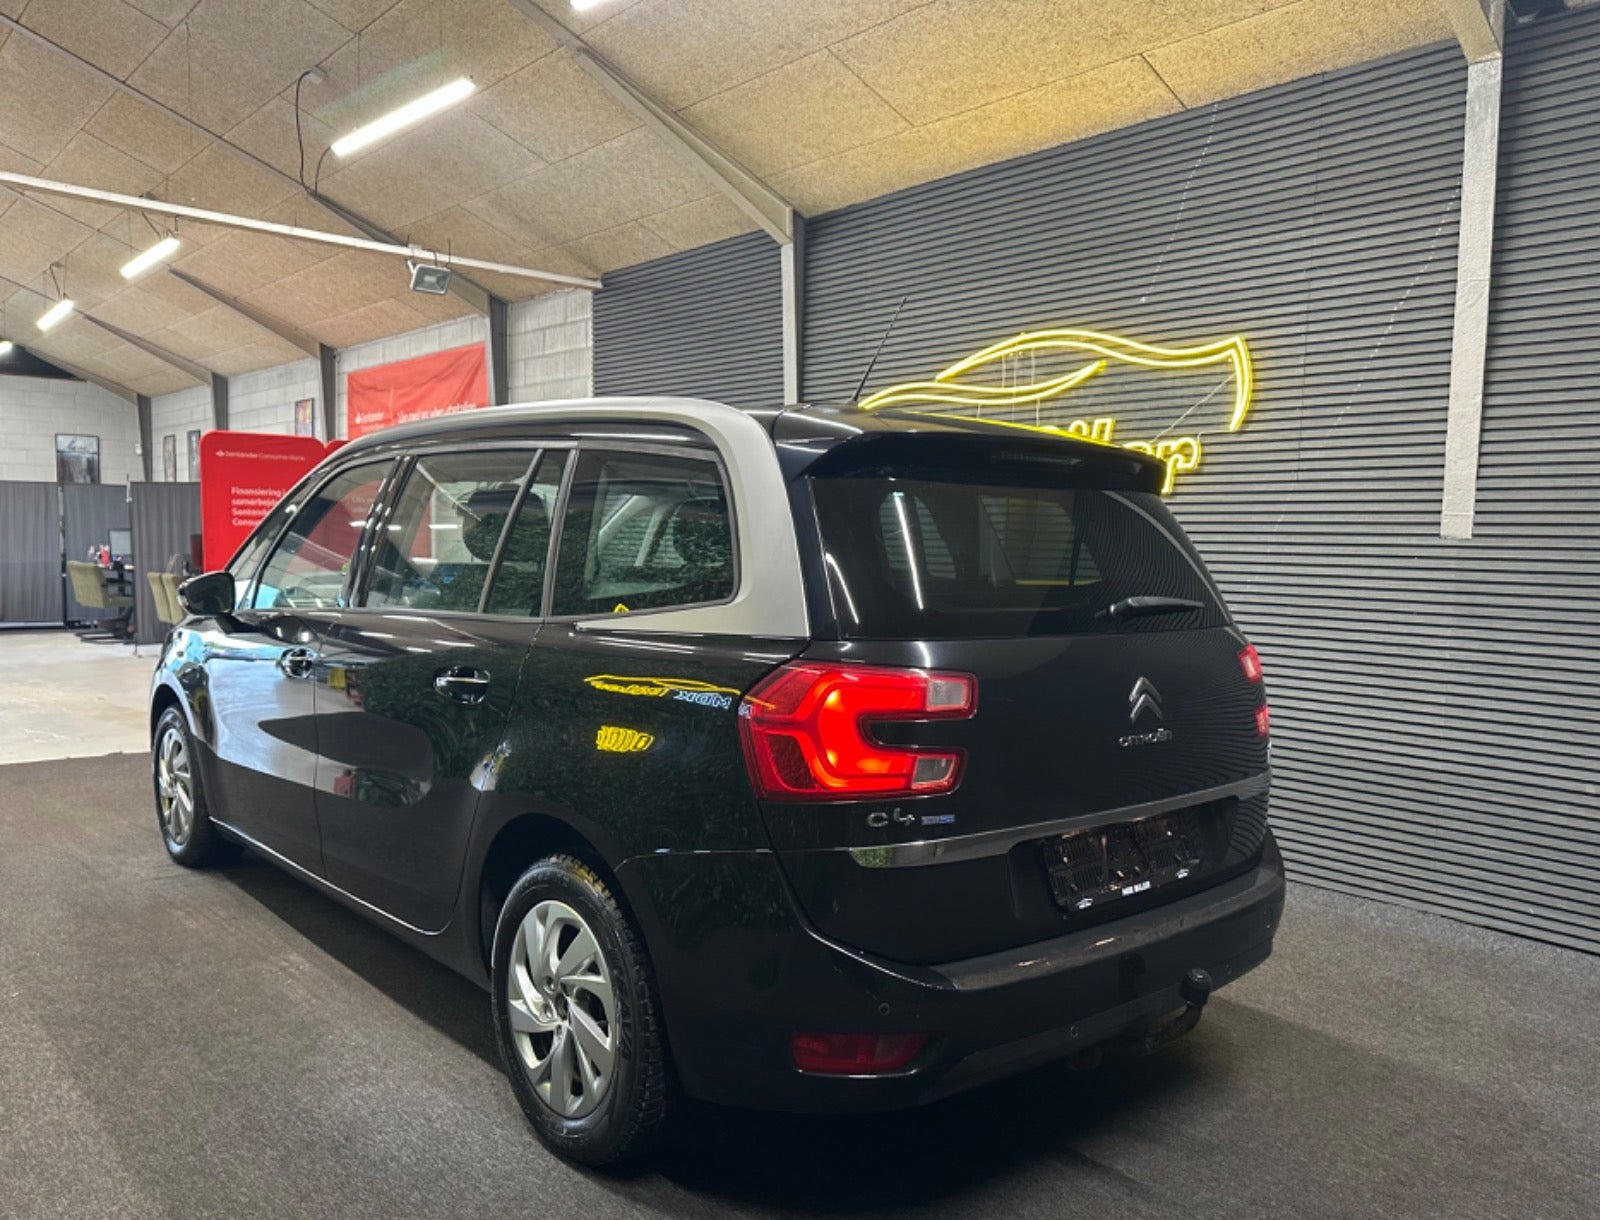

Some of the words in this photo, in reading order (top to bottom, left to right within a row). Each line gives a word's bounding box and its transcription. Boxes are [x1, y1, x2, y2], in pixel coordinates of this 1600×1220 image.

[225, 450, 258, 459] Santander
[231, 486, 281, 498] Finansiering
[231, 498, 277, 508] samarbejd
[231, 507, 267, 517] Santand
[232, 517, 260, 526] Consu
[866, 806, 916, 828] C4
